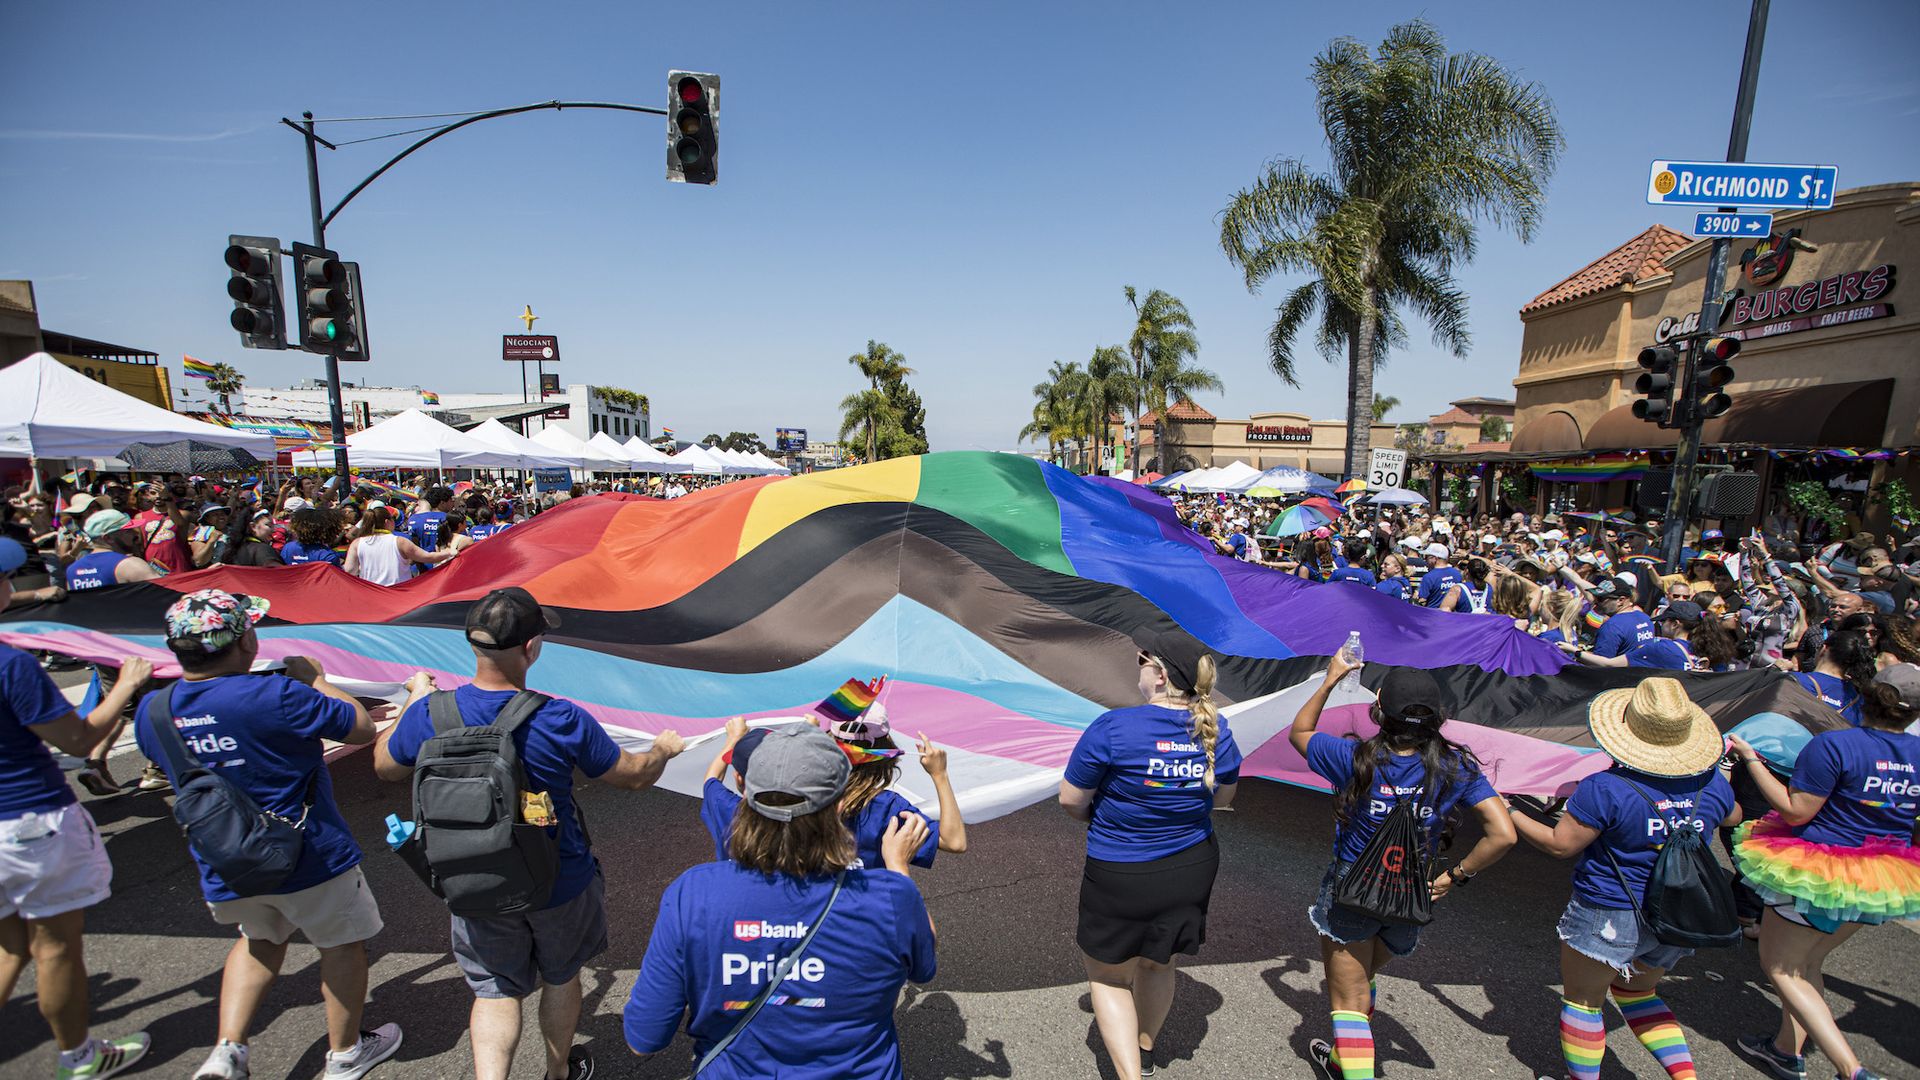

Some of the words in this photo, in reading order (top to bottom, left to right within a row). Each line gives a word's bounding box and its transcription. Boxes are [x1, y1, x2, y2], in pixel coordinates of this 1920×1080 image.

[1678, 171, 1789, 198] RICHMOND
[1798, 175, 1828, 200] ST.
[1703, 217, 1740, 233] 3900
[1733, 264, 1889, 325] BURGERS
[1763, 321, 1792, 336] SHAKES
[1821, 310, 1846, 326] CRAFT
[1847, 306, 1875, 321] BEERS
[1375, 452, 1404, 462] SPEED
[1376, 462, 1399, 470] LIMIT
[1371, 470, 1398, 487] 30
[424, 523, 438, 531] Prid
[174, 714, 217, 728] sbank
[1156, 741, 1200, 753] usbank
[1147, 758, 1204, 778] Pride
[1875, 761, 1915, 773] usbank
[1863, 776, 1920, 797] Pride
[735, 921, 810, 938] usbank
